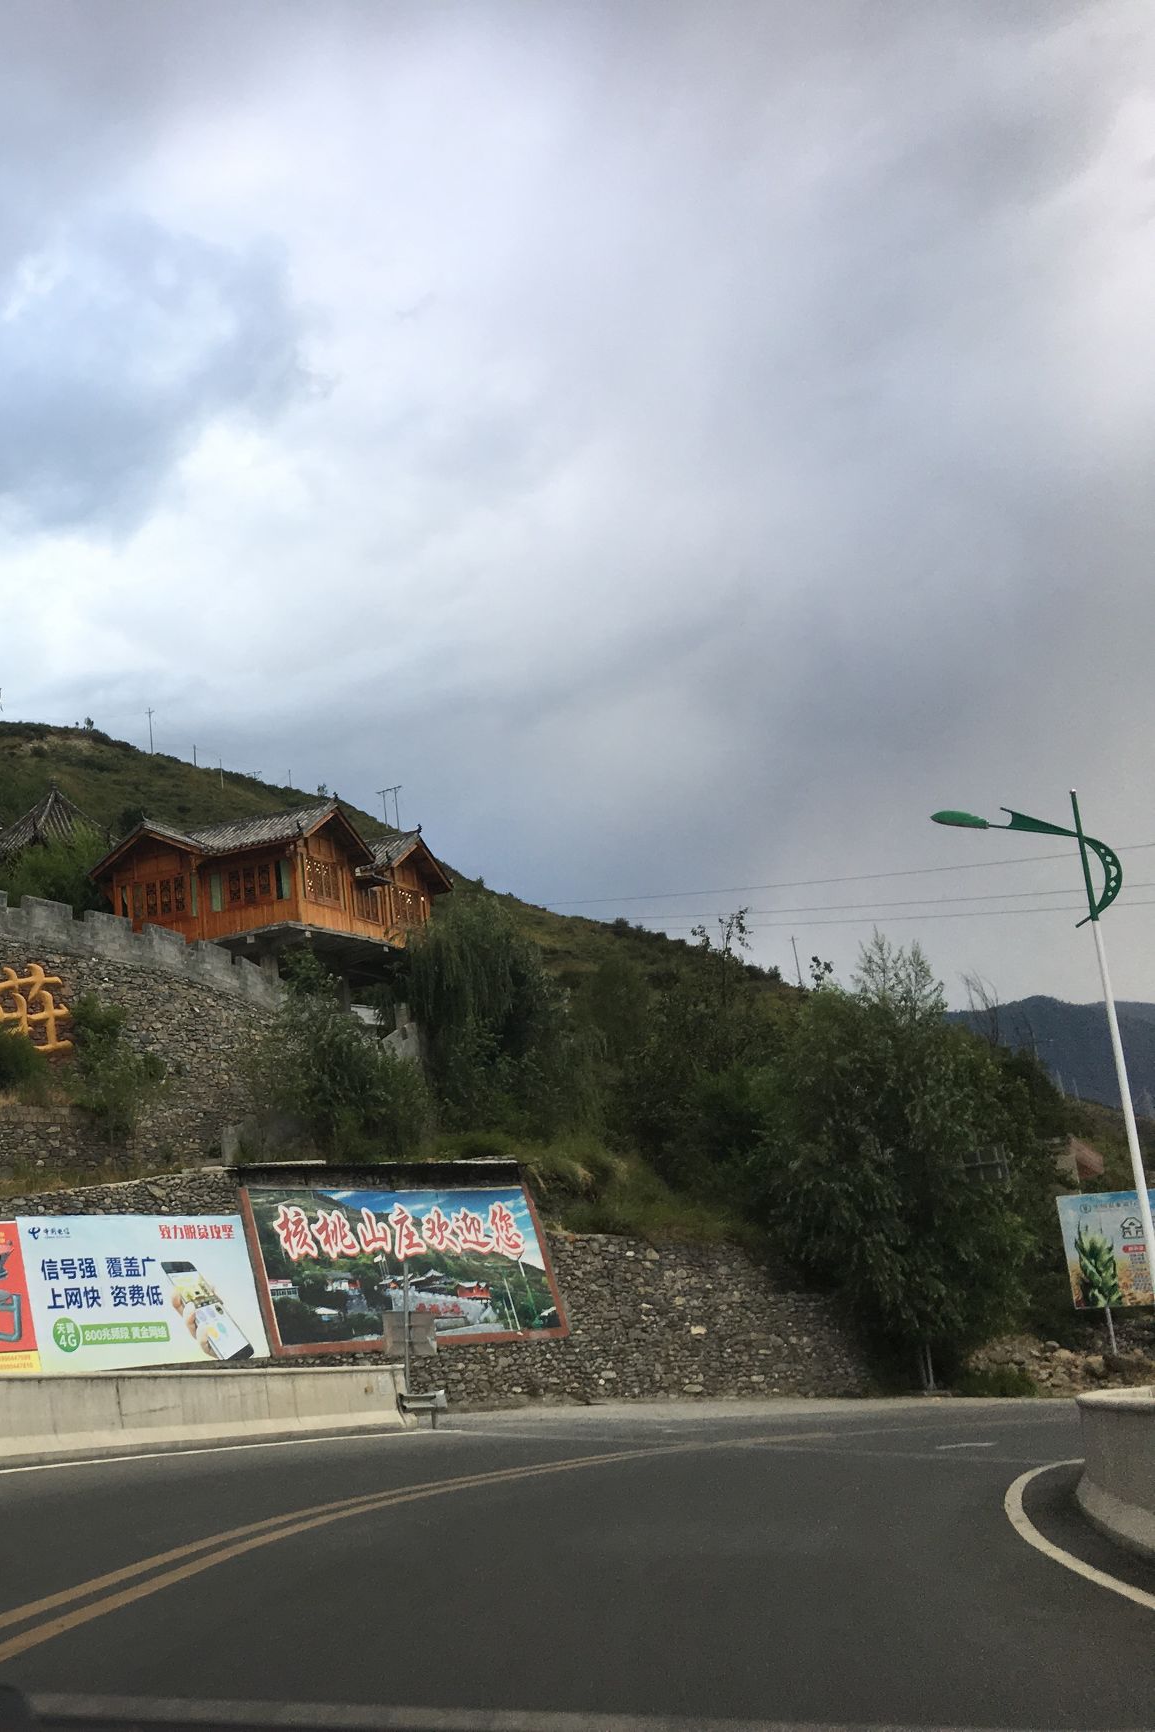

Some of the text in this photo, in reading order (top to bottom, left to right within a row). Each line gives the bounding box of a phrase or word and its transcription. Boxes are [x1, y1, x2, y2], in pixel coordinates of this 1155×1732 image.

[158, 1224, 235, 1239] 致力脱贫攻坚
[273, 1201, 526, 1262] 核桃山庄欢迎您
[40, 1256, 156, 1281] 信号强 覆盖广
[47, 1285, 164, 1310] 上网快 资费低
[59, 1334, 77, 1347] 4G
